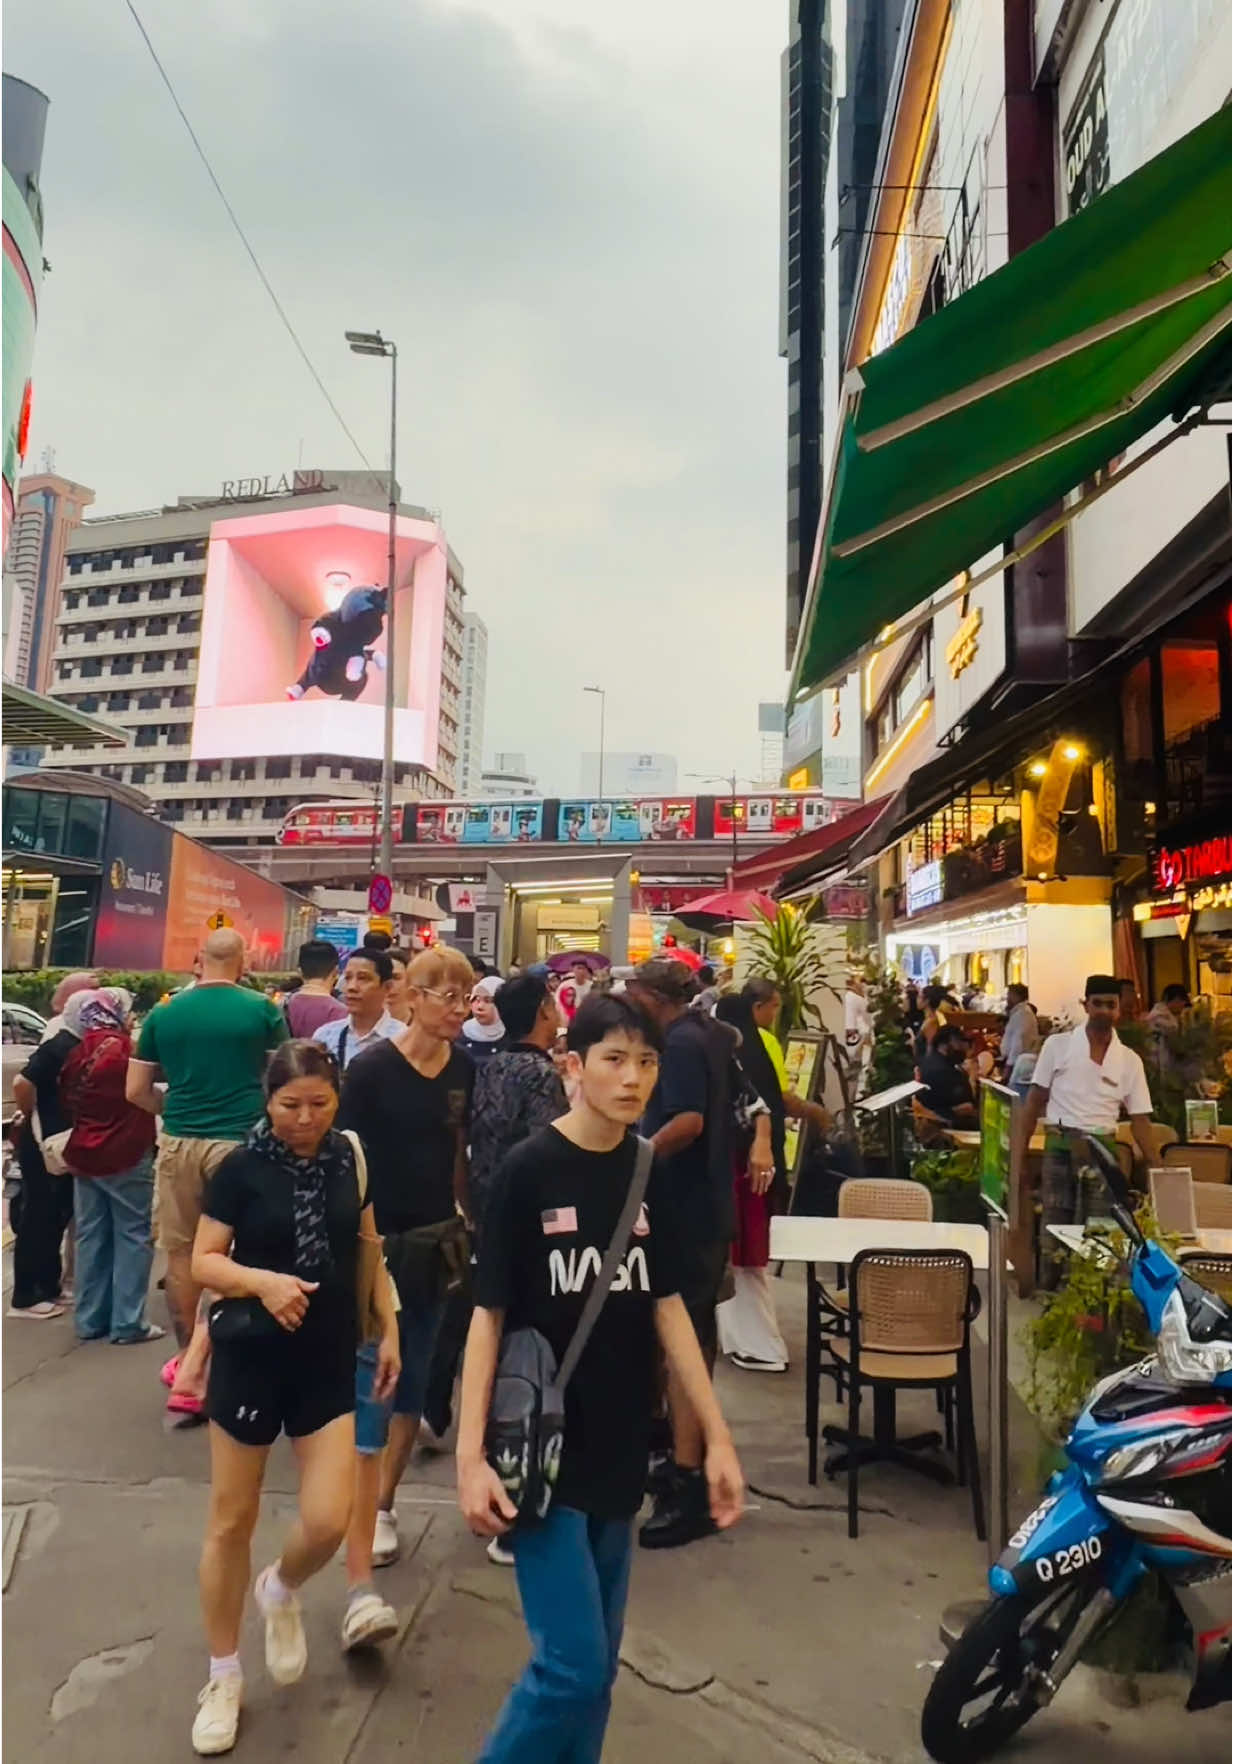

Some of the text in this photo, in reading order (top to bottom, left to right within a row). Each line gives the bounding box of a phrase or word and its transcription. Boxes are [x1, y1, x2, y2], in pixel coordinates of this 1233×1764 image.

[221, 469, 325, 499] REDLAND
[126, 867, 145, 891] Sun
[145, 871, 163, 895] Life
[1035, 1536, 1102, 1582] Q 2310
